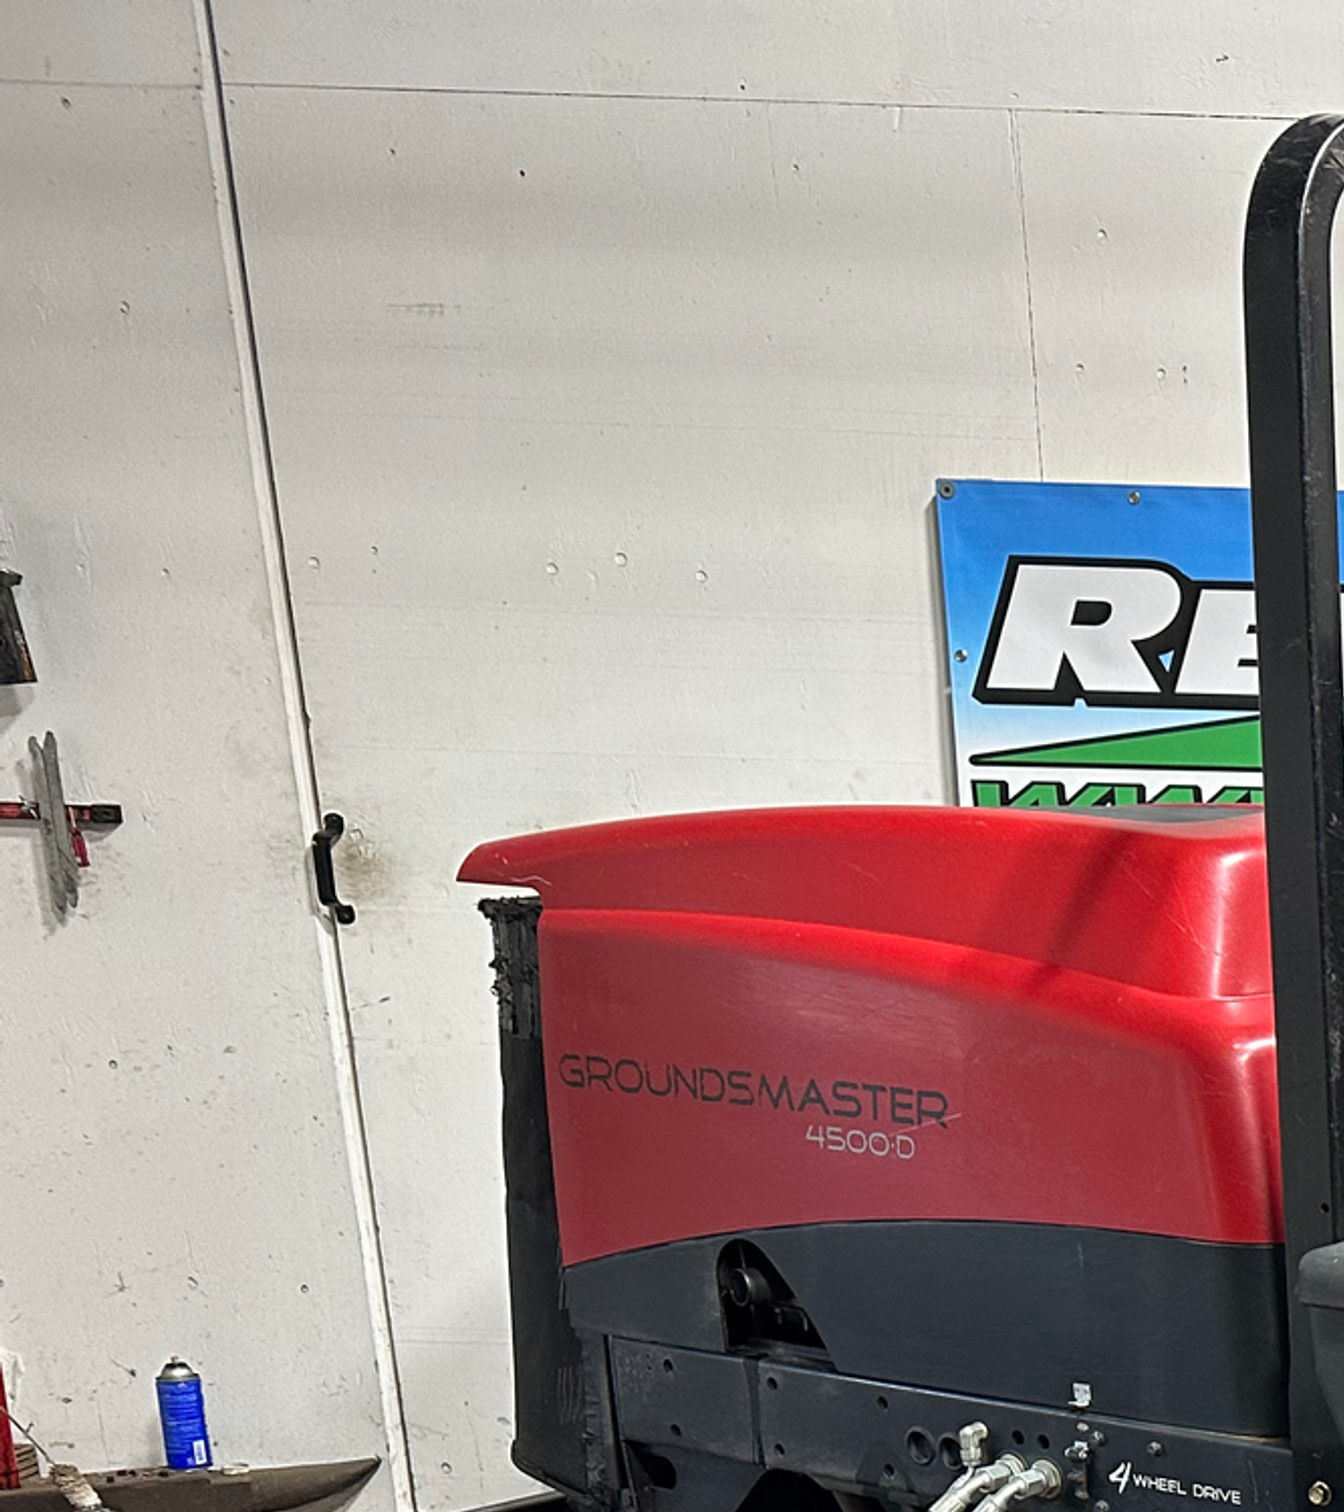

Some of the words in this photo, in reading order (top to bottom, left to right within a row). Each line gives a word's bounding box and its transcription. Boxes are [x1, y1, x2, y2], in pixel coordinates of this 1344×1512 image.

[559, 1053, 949, 1130] GROUNDSMASTER
[1108, 1461, 1132, 1495] 4
[1132, 1473, 1188, 1497] WHEEL
[1192, 1483, 1242, 1506] DRIVE
